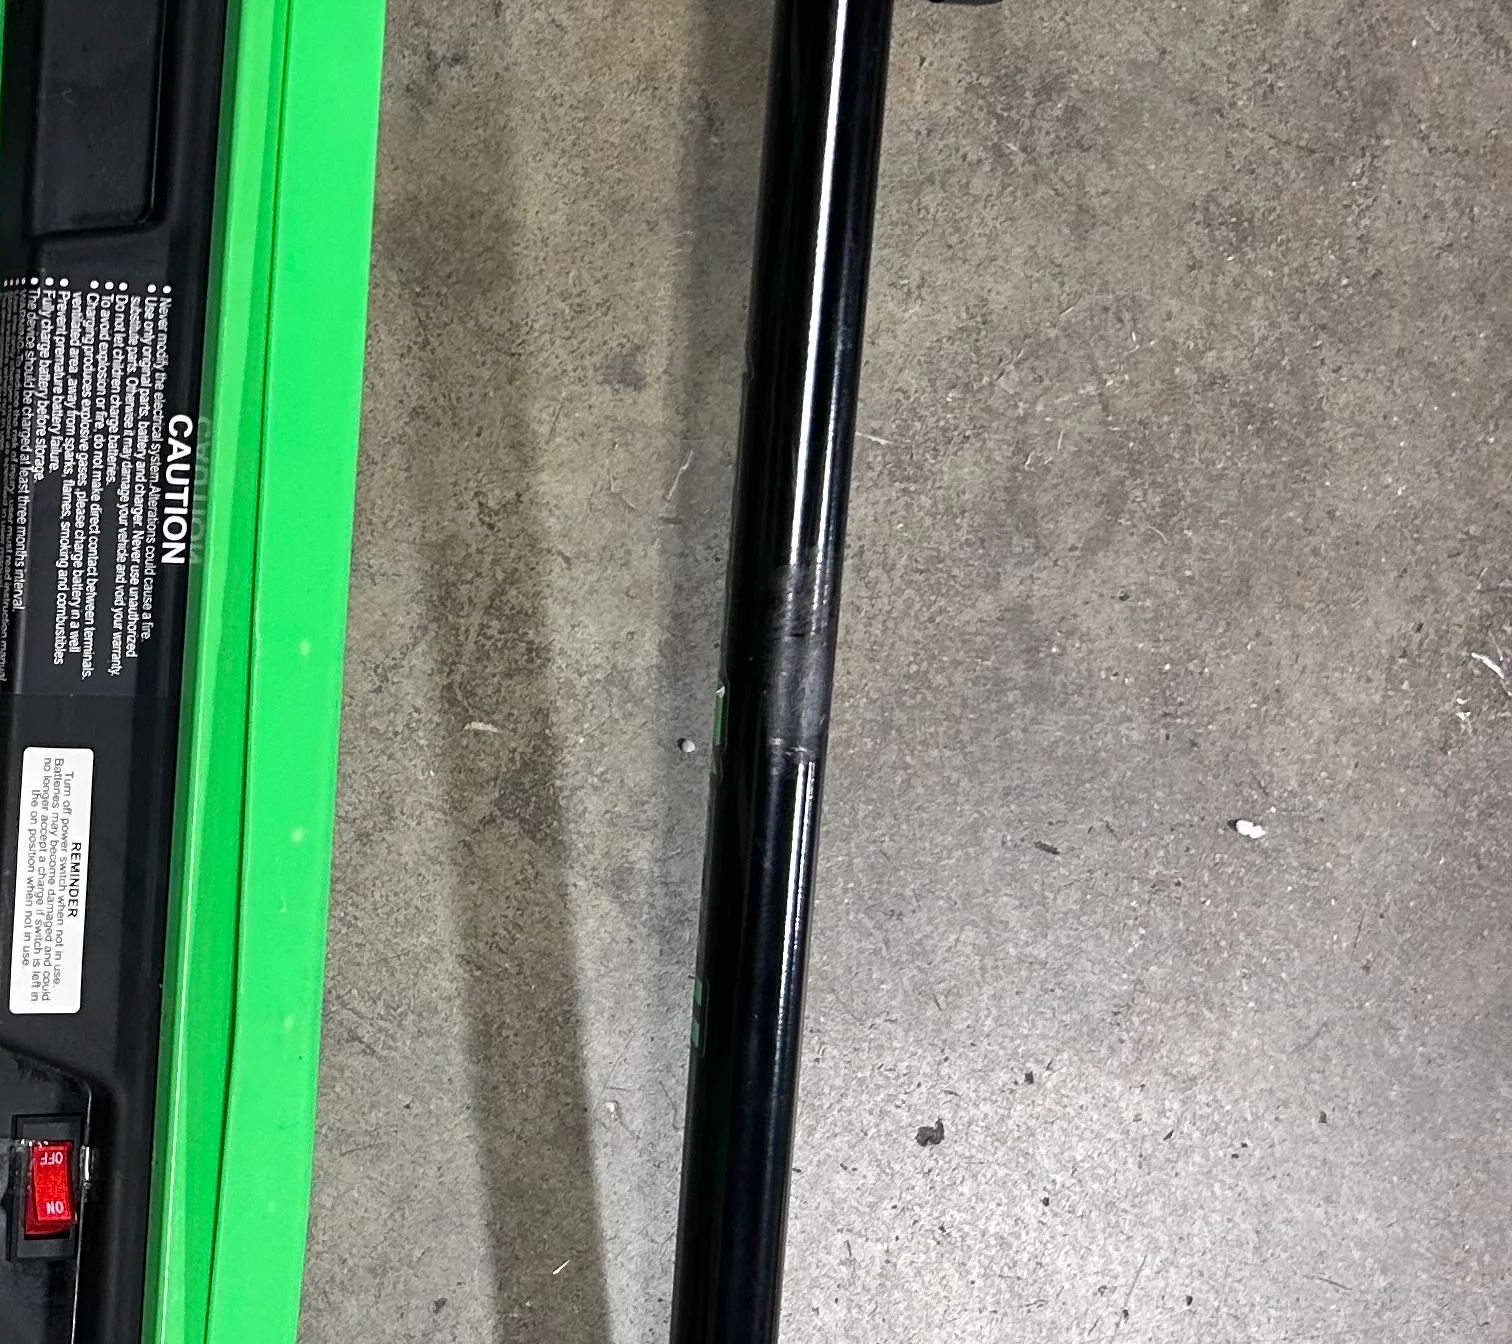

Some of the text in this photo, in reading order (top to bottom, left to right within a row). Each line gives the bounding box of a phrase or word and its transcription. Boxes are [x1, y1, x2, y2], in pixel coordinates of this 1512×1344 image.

[27, 287, 39, 309] The
[38, 289, 54, 316] Fully
[55, 291, 69, 334] Prevent
[100, 294, 113, 307] To
[114, 294, 127, 311] Do
[98, 309, 112, 340] avoid
[113, 313, 126, 331] not
[156, 297, 171, 331] Never
[25, 311, 38, 348] device
[36, 318, 53, 358] charge
[112, 333, 125, 346] let
[50, 336, 66, 393] premature
[152, 333, 169, 369] modify
[23, 350, 36, 387] should
[34, 359, 51, 398] battery
[94, 342, 110, 395] explosion
[110, 349, 124, 392] children
[153, 372, 167, 390] the
[22, 390, 34, 403] be
[95, 397, 104, 408] or
[35, 400, 49, 435] before
[48, 395, 64, 433] battery
[105, 394, 121, 432] charge
[151, 392, 166, 441] electrical
[17, 406, 33, 451] charged
[93, 434, 105, 448] do
[19, 453, 31, 464] at
[92, 450, 105, 470] not
[18, 466, 30, 494] least
[90, 472, 103, 501] make
[161, 414, 192, 564] CAUTION
[16, 495, 29, 523] three
[89, 503, 101, 533] direct
[14, 526, 28, 566] months
[86, 536, 100, 576] contact
[144, 546, 156, 575] could
[84, 578, 97, 624] between
[142, 577, 153, 609] cause
[81, 627, 95, 680] terminals.
[43, 757, 50, 771] no
[30, 790, 40, 807] the
[39, 775, 51, 811] longer
[63, 771, 74, 796] Turn
[29, 811, 37, 824] on
[62, 800, 71, 814] off
[37, 815, 48, 852] accept
[58, 818, 69, 852] power
[25, 829, 37, 872] position
[33, 867, 46, 905] charge
[41, 758, 63, 1001] Batteries may become damaged and could
[58, 856, 68, 891] switch
[67, 842, 81, 917] REMINDER
[25, 876, 34, 906] when
[24, 910, 33, 928] not
[56, 895, 65, 925] when
[23, 932, 31, 941] in
[33, 919, 44, 954] switch
[55, 929, 64, 946] not
[32, 959, 42, 967] is
[54, 951, 62, 960] in
[31, 971, 41, 988] left
[30, 992, 40, 1001] in
[40, 1151, 62, 1164] OFF
[46, 1200, 63, 1214] ON
